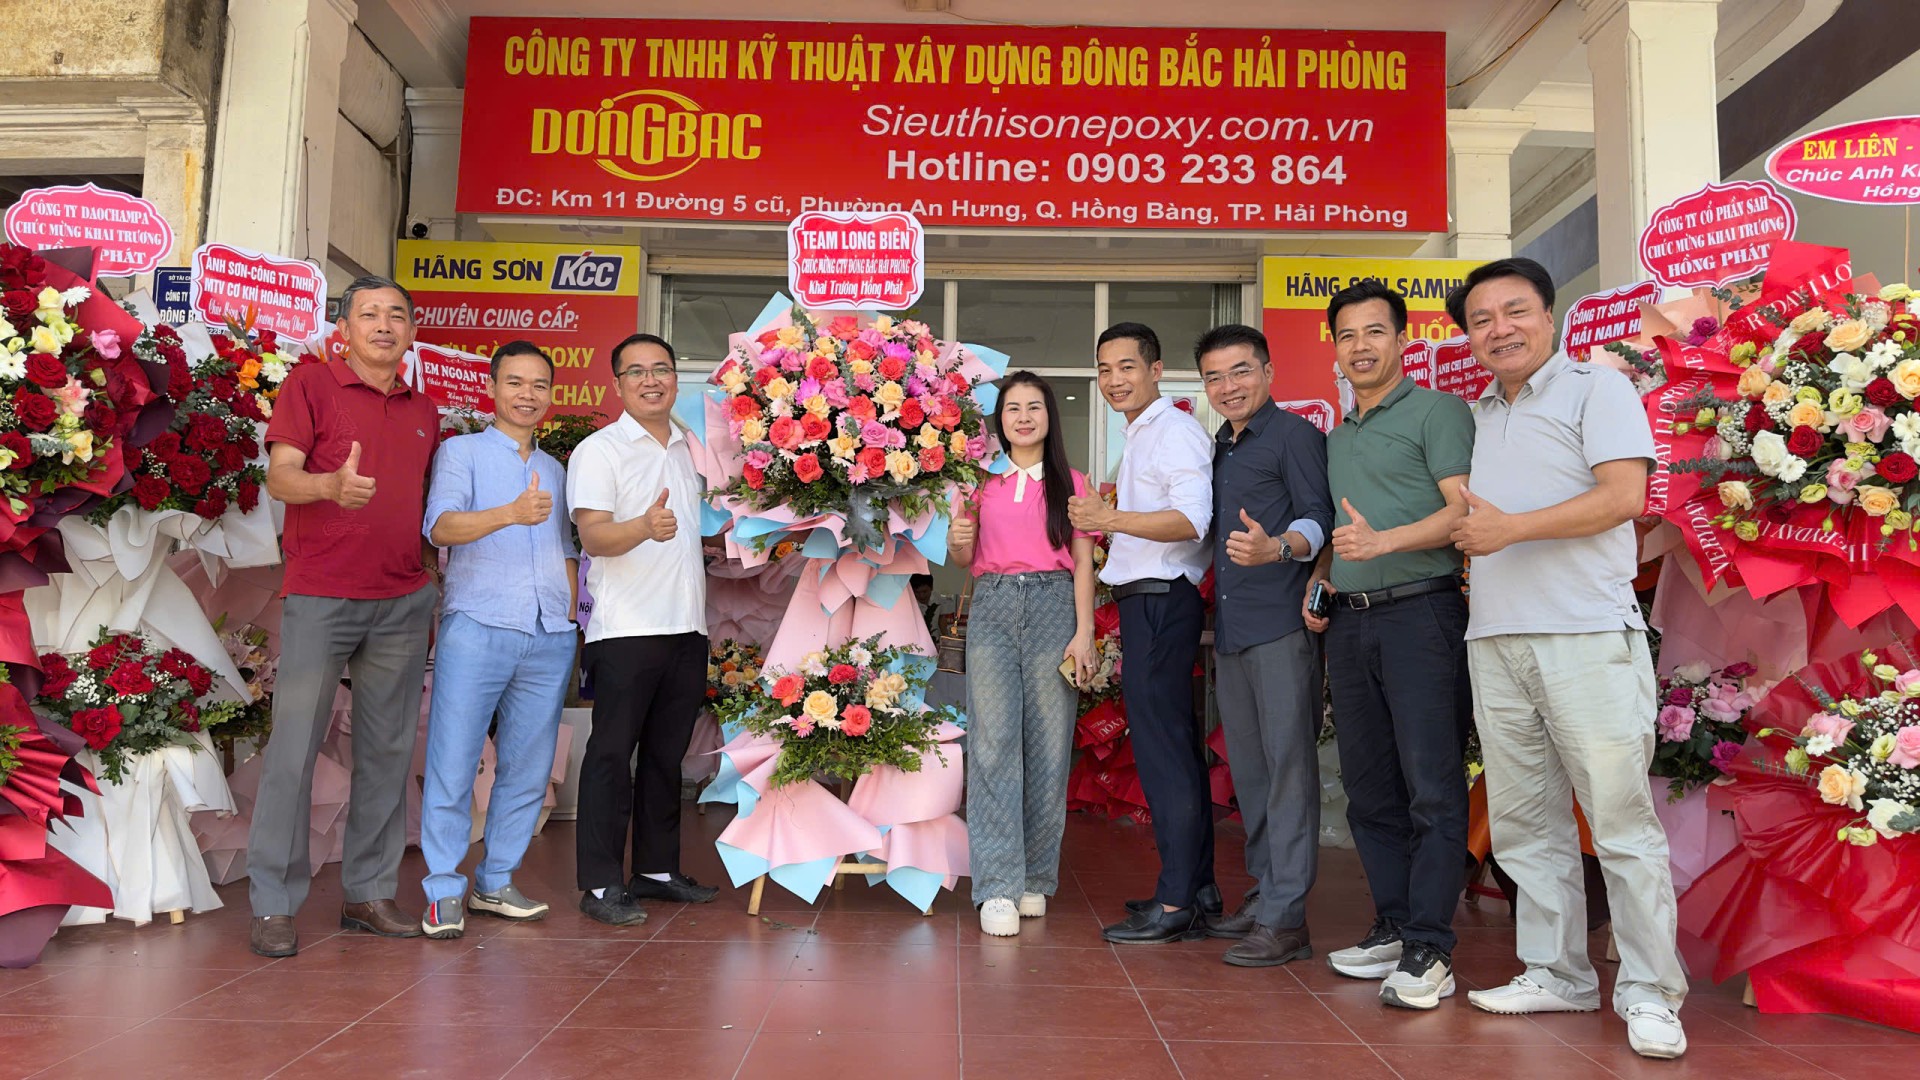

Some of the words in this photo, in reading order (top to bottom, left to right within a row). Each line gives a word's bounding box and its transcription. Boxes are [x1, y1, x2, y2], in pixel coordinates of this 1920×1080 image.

[505, 28, 590, 76] CÔNG
[601, 37, 636, 77] TY
[646, 38, 728, 79] TNHH
[737, 33, 779, 81] KỸ
[788, 34, 885, 91] THUẬT
[894, 36, 956, 84] XÂY
[966, 42, 1051, 94] DỰNG
[1061, 38, 1148, 87] ĐÔNG
[1159, 33, 1223, 87] BẮC
[1234, 36, 1286, 88] HẢI
[1297, 41, 1407, 91] PHÒNG
[862, 104, 1374, 148] Sieuthisonepoxy.com.vn
[1802, 140, 1837, 160] EM
[1844, 133, 1899, 159] LIÊN
[887, 149, 1050, 182] Hotline:
[1066, 152, 1166, 184] 0903
[1180, 153, 1256, 185] 233
[1271, 154, 1347, 186] 864
[1786, 167, 1843, 183] Chúc
[1848, 165, 1894, 181] Anh
[1863, 183, 1920, 199] Hồng
[30, 198, 62, 217] CÔNG
[64, 203, 78, 218] TY
[81, 206, 150, 226] DAOCHAMPA
[496, 188, 542, 206] ĐC:
[551, 190, 593, 208] Km
[602, 191, 626, 209] 11
[636, 190, 724, 214] Đường
[733, 194, 747, 212] 5
[754, 192, 792, 216] cũ,
[910, 198, 944, 217] An
[952, 199, 1027, 222] Hưng,
[1036, 200, 1062, 220] Q.
[1072, 197, 1138, 223] Hồng
[1147, 201, 1219, 225] Bàng,
[1228, 203, 1266, 222] TP.
[1274, 202, 1316, 222] Hải
[1324, 203, 1408, 227] Phòng
[1658, 215, 1684, 236] CÔNG
[1685, 213, 1698, 229] TY
[1700, 200, 1714, 226] CỔ
[1715, 196, 1744, 221] PHẦN
[1746, 195, 1769, 214] SAH
[15, 218, 47, 235] CHÚC
[49, 220, 82, 239] MỪNG
[84, 227, 114, 241] KHAI
[117, 230, 162, 246] TRƯƠNG
[802, 230, 838, 250] TEAM
[841, 230, 876, 250] LONG
[879, 228, 911, 250] BIÊN
[1647, 238, 1674, 260] CHÚC
[1675, 233, 1705, 253] MỪNG
[1707, 230, 1736, 247] KHAI
[1738, 216, 1785, 240] TRƯƠNG
[100, 247, 146, 265] PHÁT
[413, 254, 482, 280] HÃNG
[493, 258, 543, 282] SƠN
[558, 251, 615, 288] KCC
[1667, 254, 1717, 278] HỒNG
[1720, 242, 1771, 267] PHÁT
[205, 256, 226, 274] ANH
[278, 271, 290, 288] TY
[291, 274, 315, 293] TNHH
[809, 279, 827, 295] Khai
[884, 278, 904, 295] Phát
[1286, 272, 1340, 298] HÃNG
[165, 290, 180, 302] CÔNG
[204, 277, 225, 296] MTV
[227, 280, 241, 298] CƠ
[242, 284, 259, 303] KHÍ
[260, 288, 293, 308] HOÀNG
[294, 295, 314, 314] SƠN
[414, 302, 482, 328] CHUYÊN
[482, 308, 534, 328] CUNG
[537, 302, 580, 329] CẤP:
[1571, 307, 1596, 327] CÔNG
[1596, 304, 1608, 320] TY
[1607, 300, 1627, 318] SƠN
[1570, 325, 1593, 347] HẢI
[1594, 321, 1626, 342] NAM
[424, 361, 439, 376] EM
[441, 364, 478, 383] NGOAN
[1404, 350, 1429, 367] EPOXY
[1437, 362, 1450, 376] ANH
